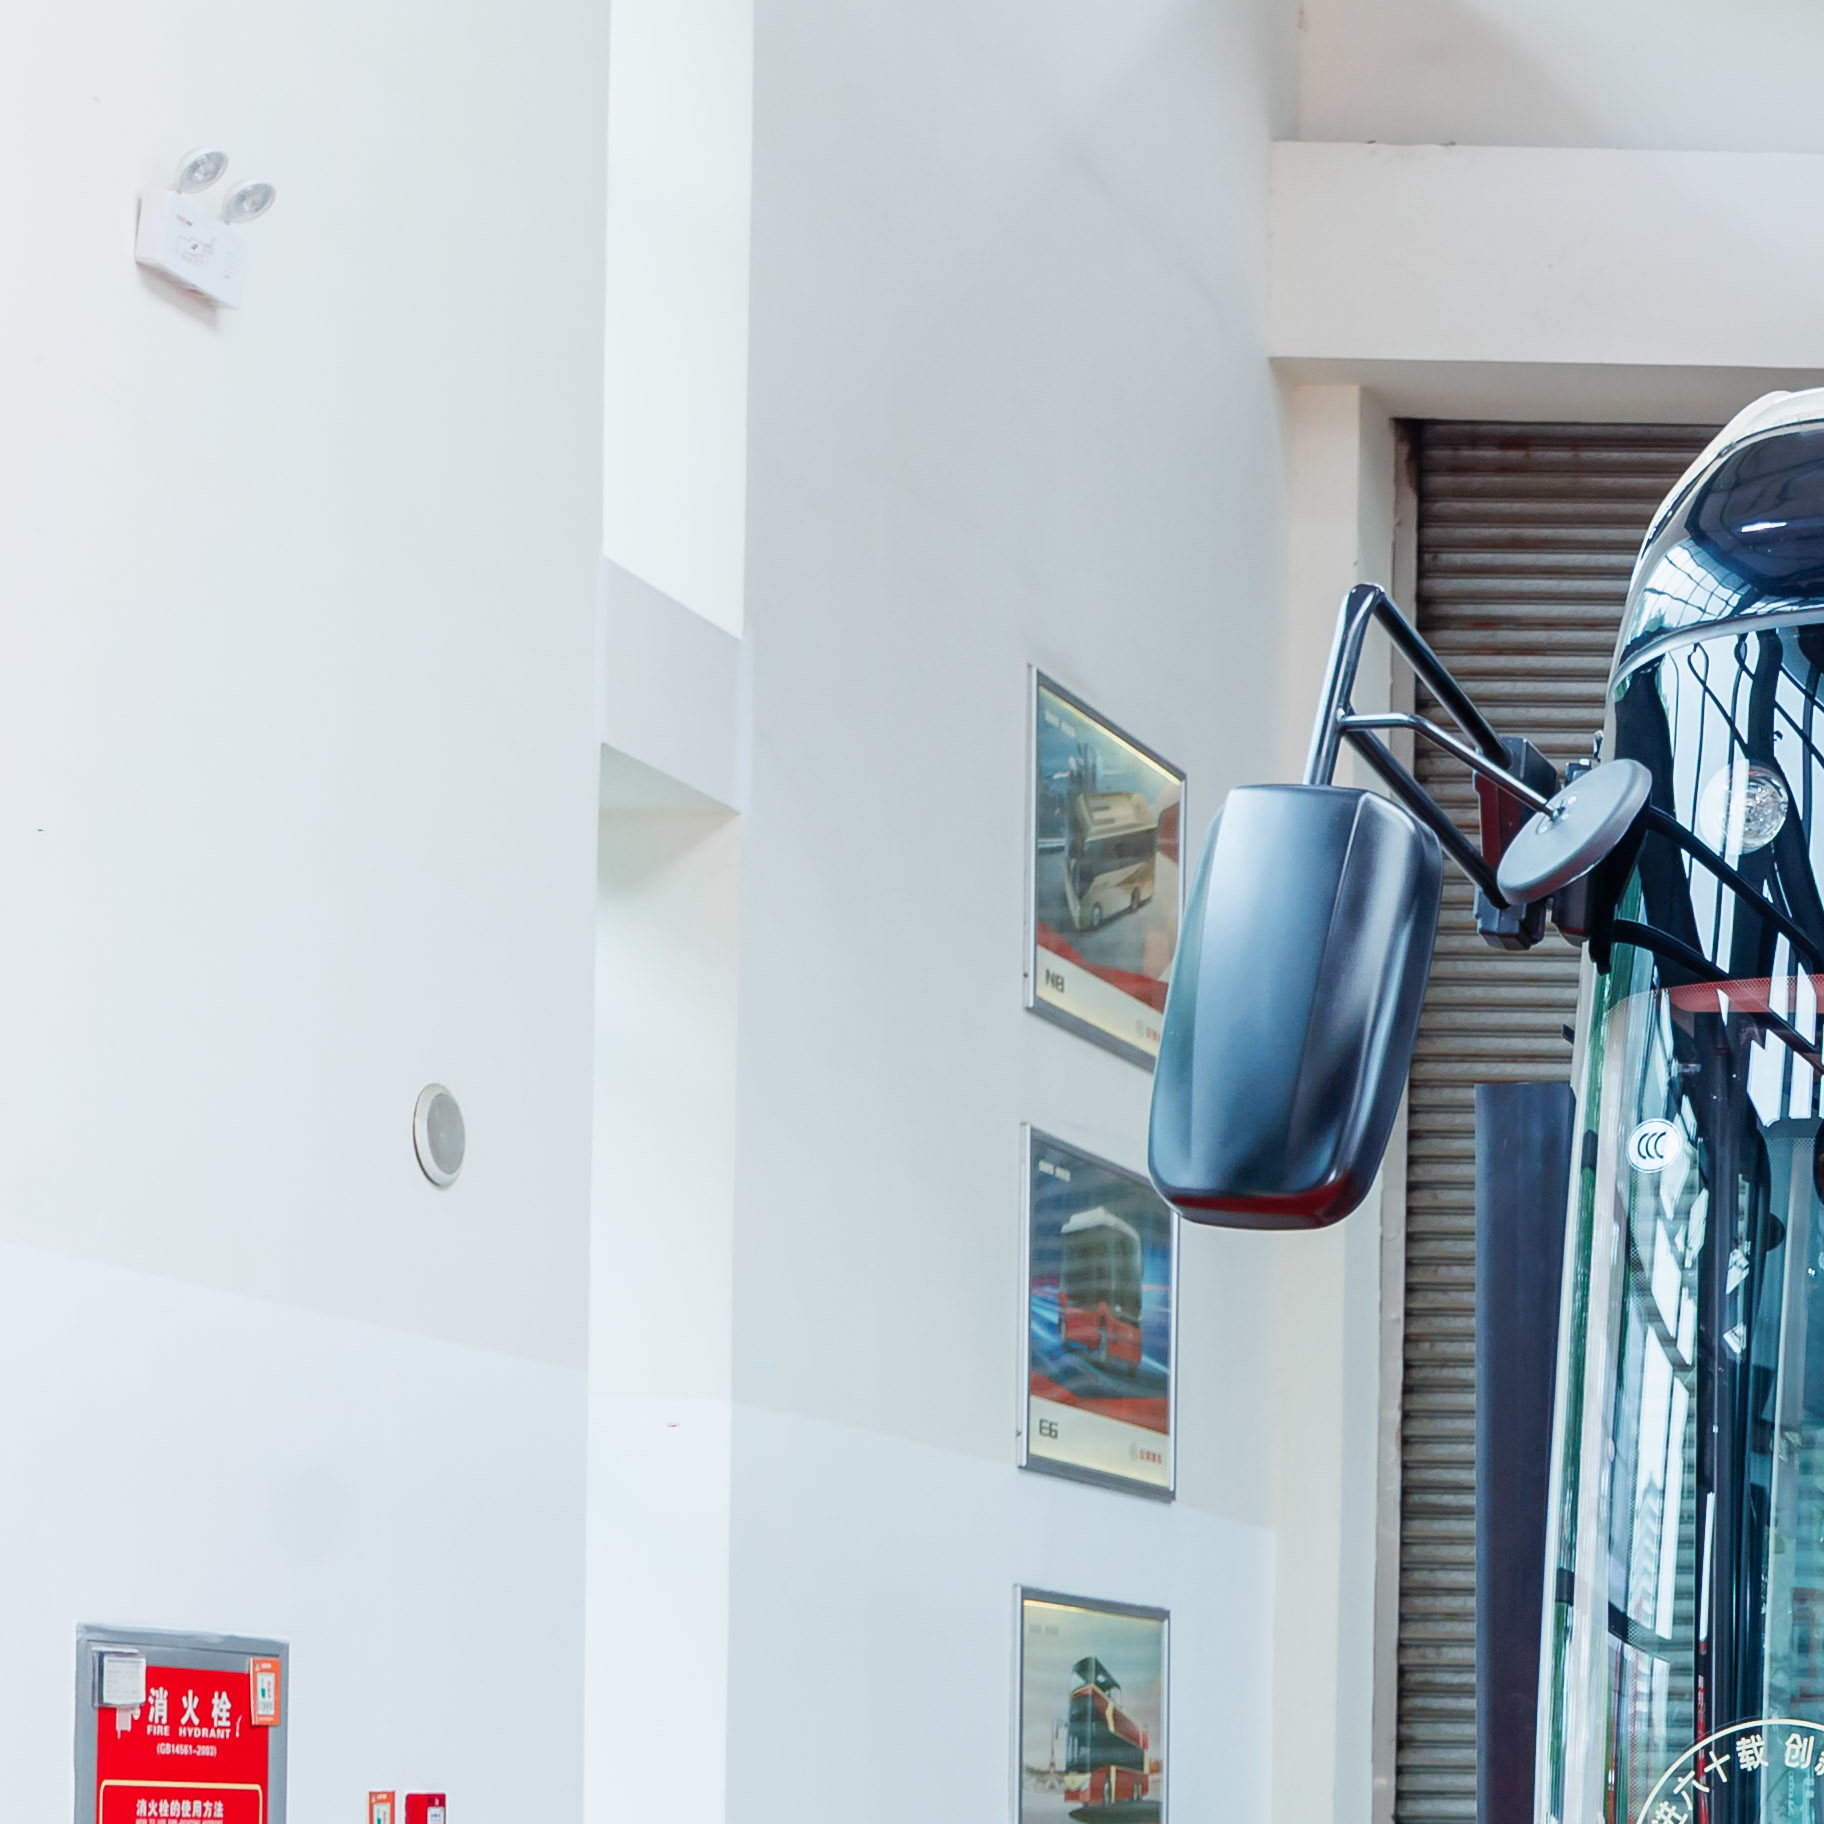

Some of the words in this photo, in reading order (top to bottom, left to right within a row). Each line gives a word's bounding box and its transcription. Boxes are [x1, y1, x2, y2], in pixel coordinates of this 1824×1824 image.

[1039, 1419, 1059, 1440] E6
[148, 1686, 232, 1728] 消火栓
[147, 1724, 170, 1737] FIRE
[178, 1726, 231, 1739] HYDRANT
[136, 1799, 224, 1819] 消火栓的使用方法
